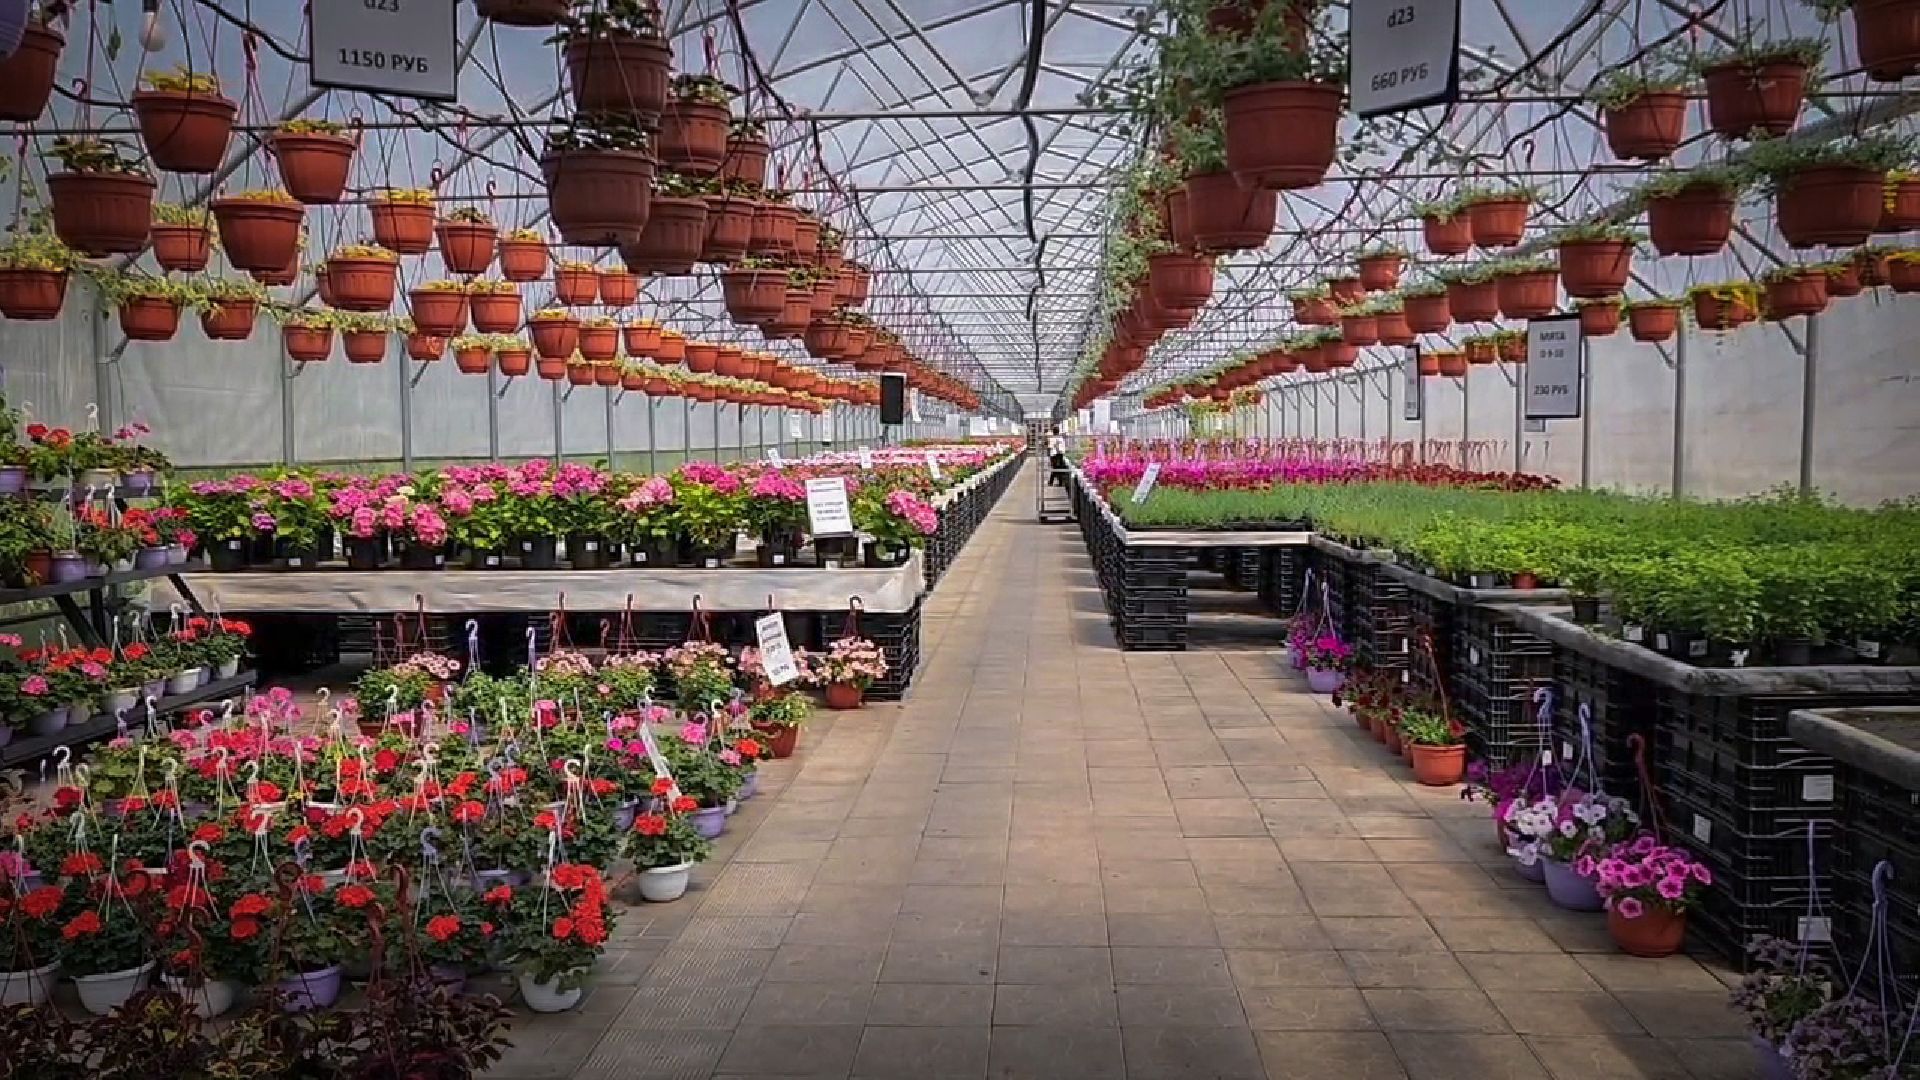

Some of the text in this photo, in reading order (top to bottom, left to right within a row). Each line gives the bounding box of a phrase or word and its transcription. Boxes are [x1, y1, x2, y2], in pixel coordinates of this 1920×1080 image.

[1387, 6, 1415, 28] d23
[339, 48, 429, 73] 1150 РУБ
[1371, 63, 1429, 91] 660 РУБ
